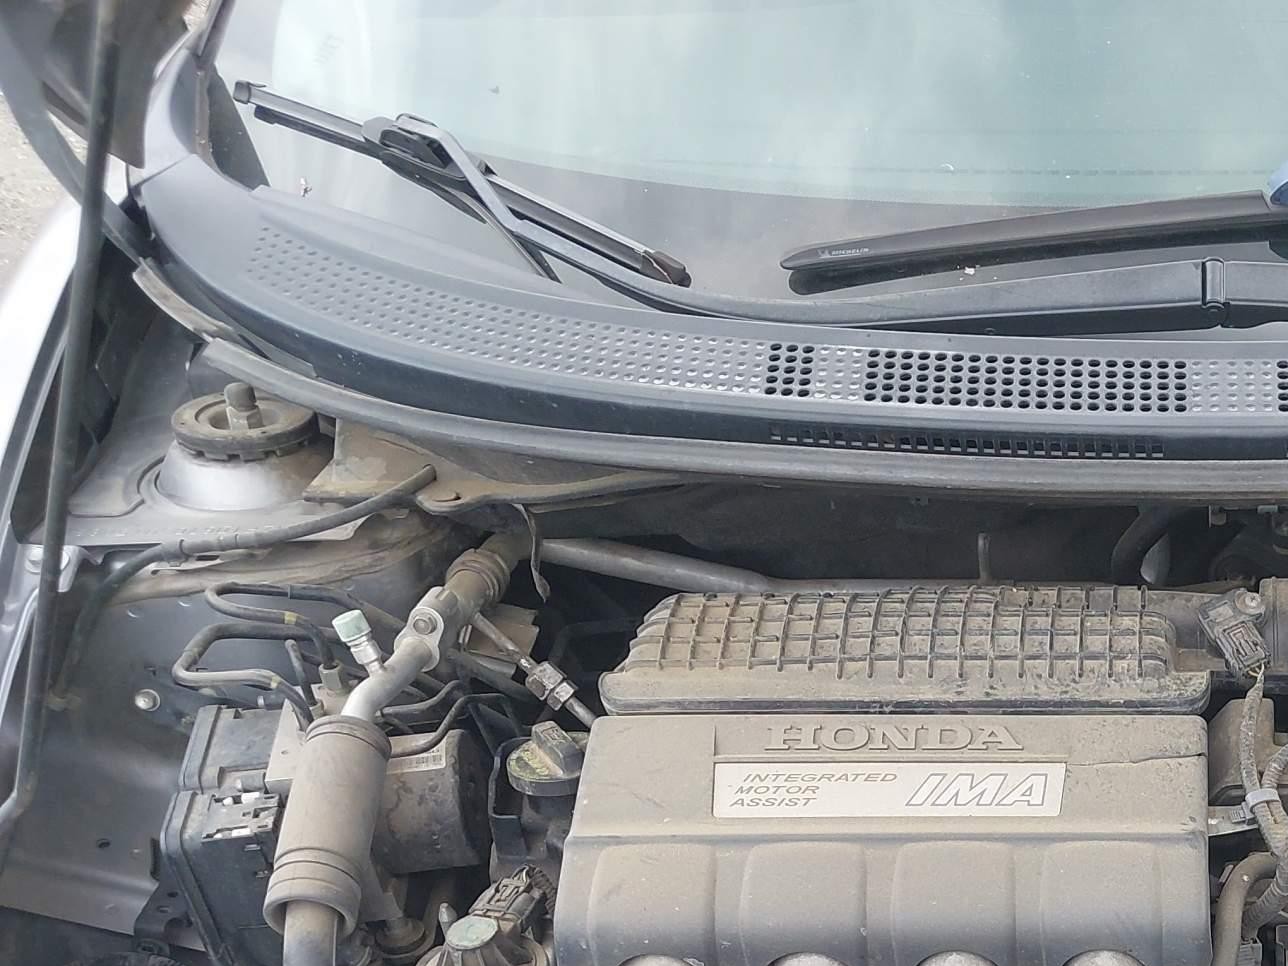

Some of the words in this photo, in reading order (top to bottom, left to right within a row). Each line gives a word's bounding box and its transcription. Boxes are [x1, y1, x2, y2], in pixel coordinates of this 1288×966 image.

[764, 724, 1024, 751] HONDA
[743, 773, 898, 783] INTEGRATED
[735, 785, 820, 795] MOTOR
[905, 773, 1048, 807] IMA
[730, 797, 817, 807] ASSIST
